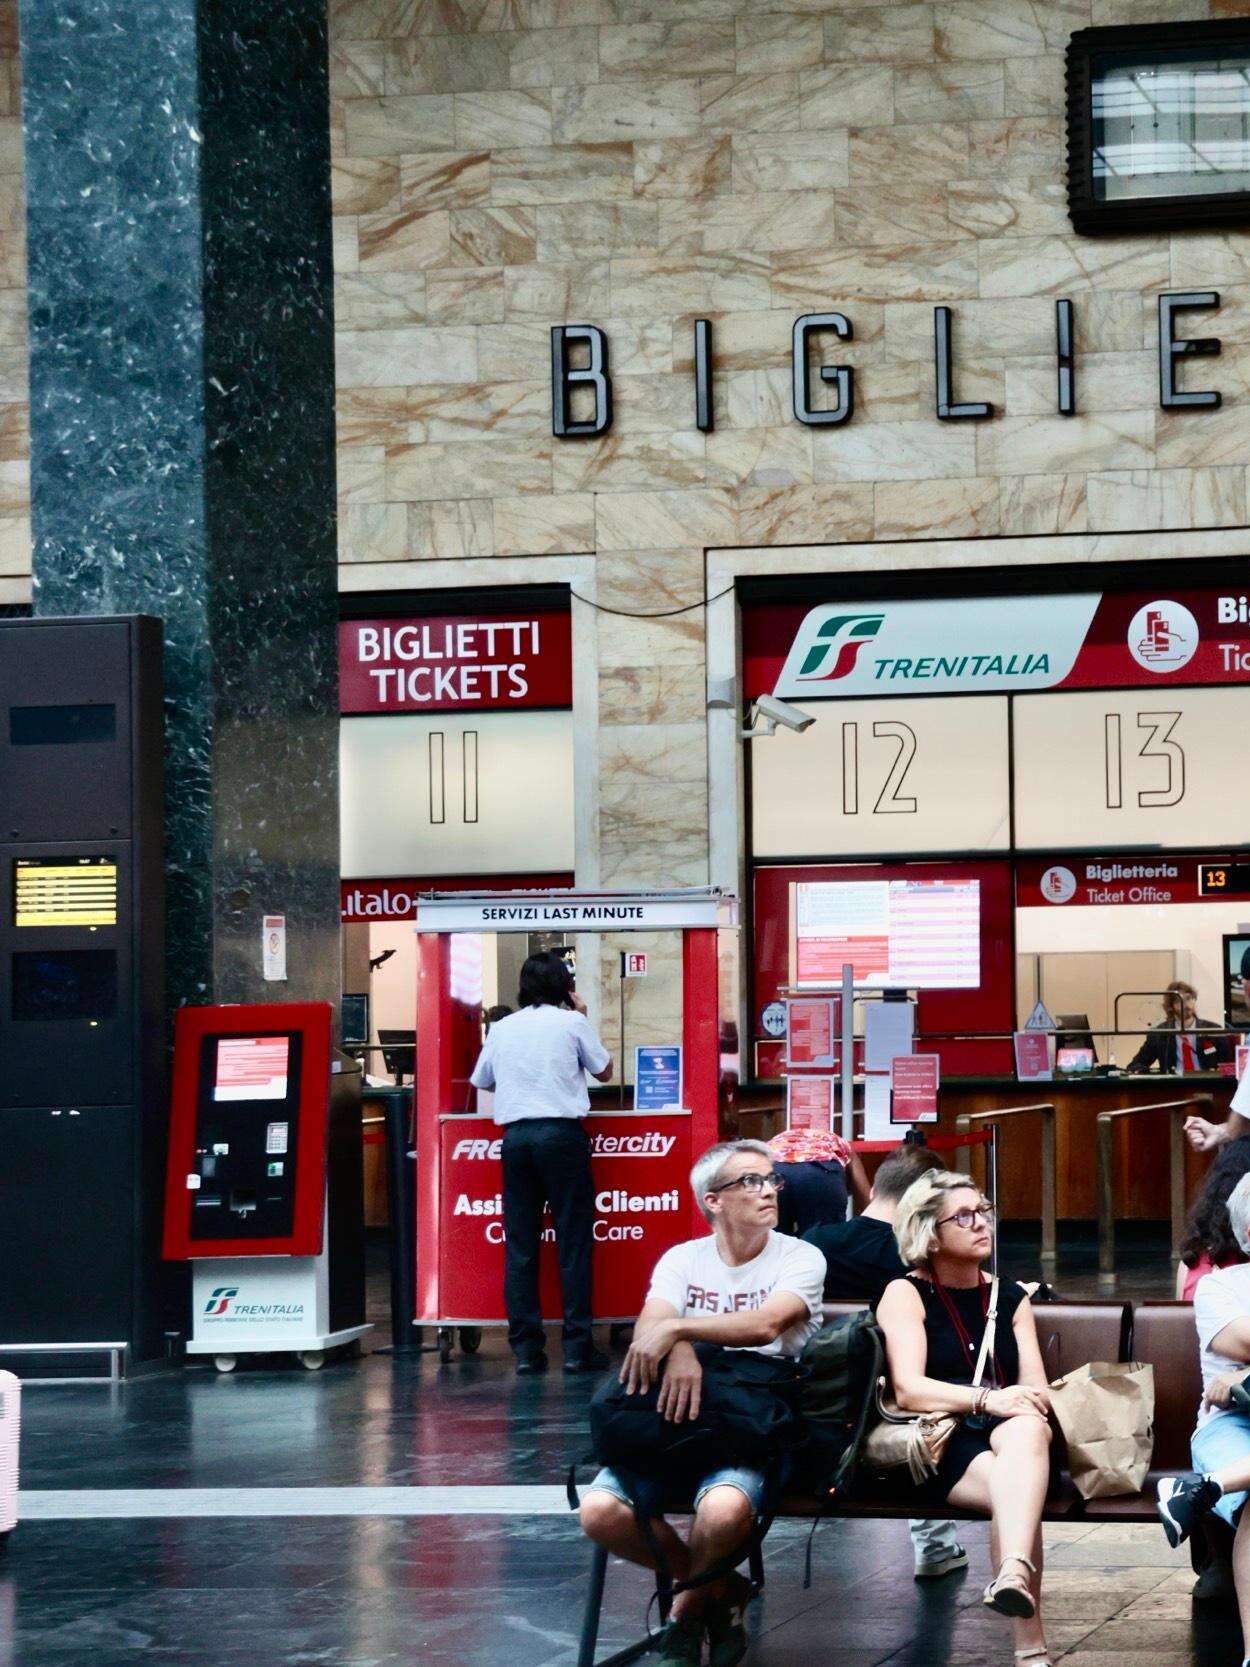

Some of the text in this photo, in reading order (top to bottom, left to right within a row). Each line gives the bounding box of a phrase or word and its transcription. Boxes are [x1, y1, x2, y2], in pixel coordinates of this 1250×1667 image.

[358, 620, 540, 662] BIGLIETTI
[873, 653, 1051, 680] TRENITALIA
[369, 663, 529, 703] TICKETS
[842, 721, 918, 815] 12
[1105, 711, 1187, 809] 13
[429, 731, 479, 824] 11
[1086, 862, 1178, 882] Biglietteria
[1206, 871, 1226, 888] 13
[1086, 885, 1172, 905] Ticket Office
[482, 906, 644, 920] SERVIZI LAST MINUTE
[595, 1189, 679, 1213] Clienti
[592, 1220, 644, 1242] Care
[233, 1304, 304, 1316] TRENITALIA
